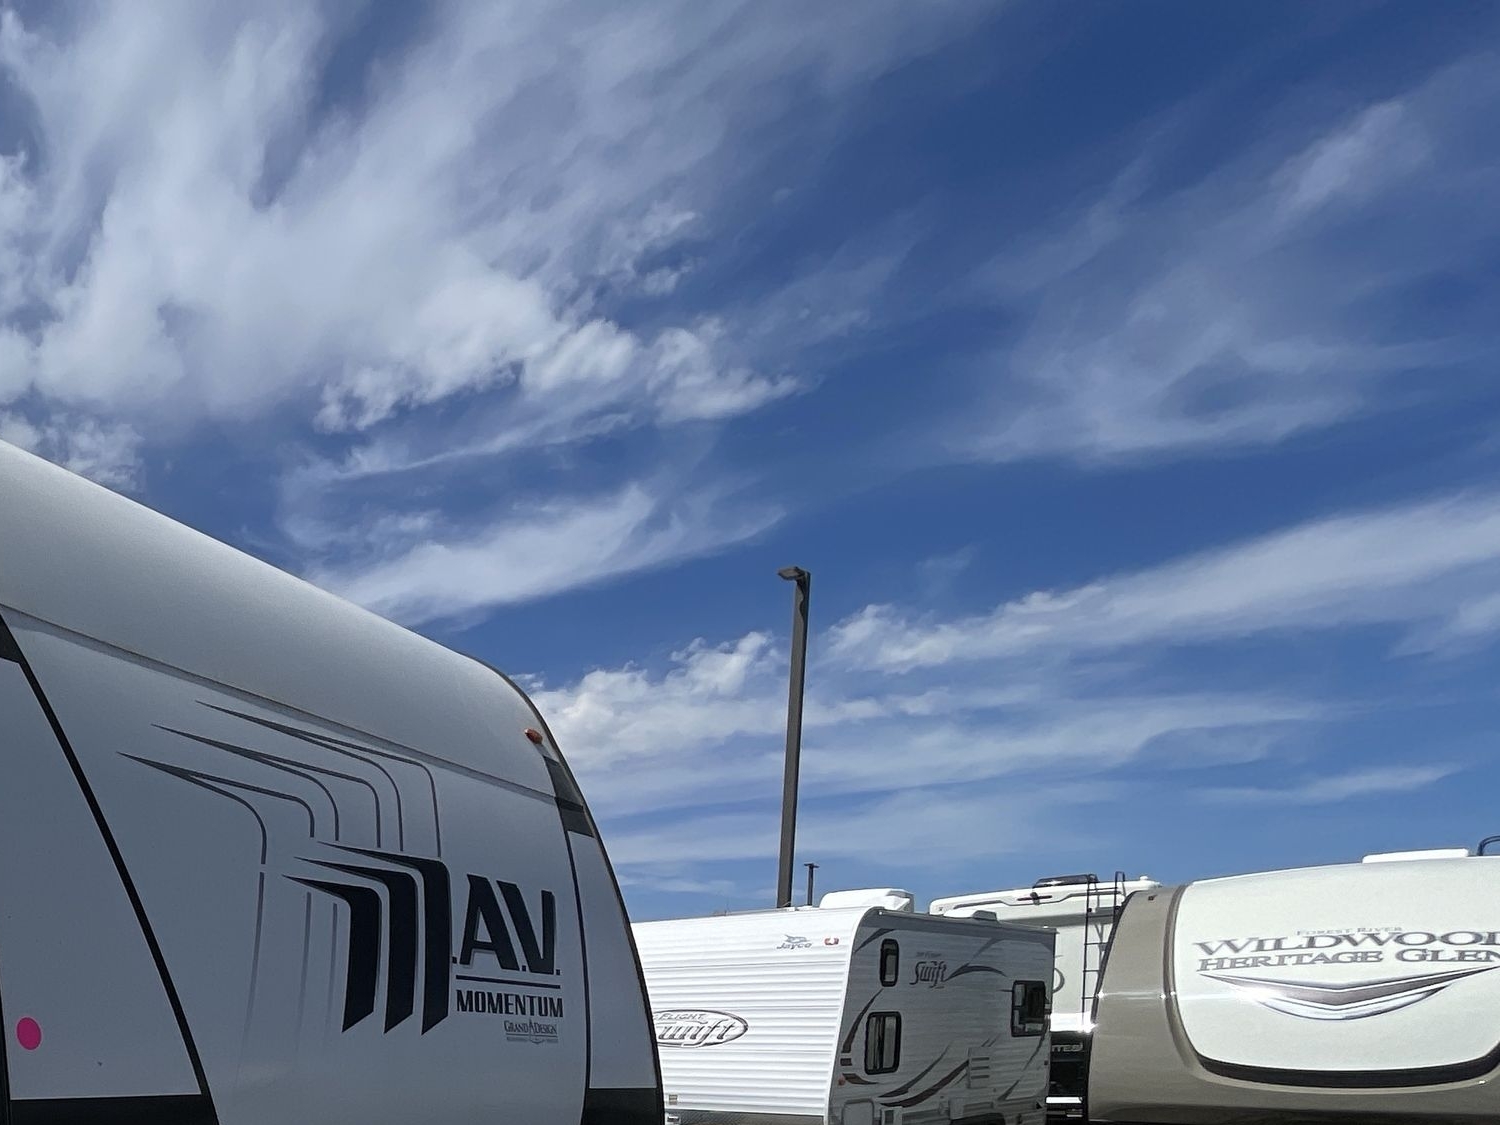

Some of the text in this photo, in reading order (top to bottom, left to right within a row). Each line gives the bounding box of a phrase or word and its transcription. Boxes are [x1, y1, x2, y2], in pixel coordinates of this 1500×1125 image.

[776, 942, 813, 950] Jayco
[909, 960, 947, 989] Swift
[1196, 950, 1384, 972] HERITAGE
[456, 989, 564, 1018] MOMENTUM
[656, 1018, 737, 1047] wift
